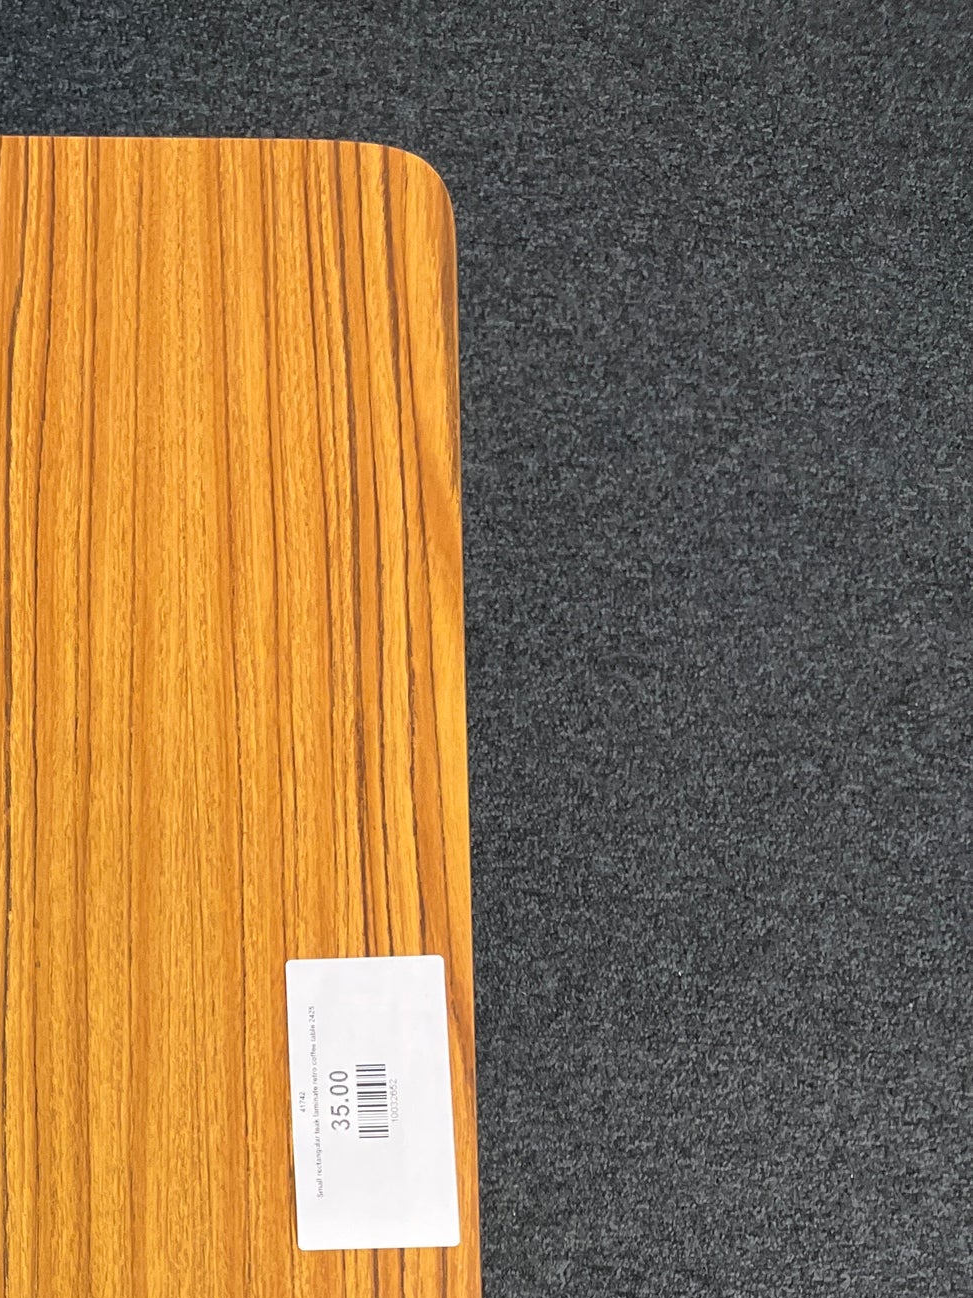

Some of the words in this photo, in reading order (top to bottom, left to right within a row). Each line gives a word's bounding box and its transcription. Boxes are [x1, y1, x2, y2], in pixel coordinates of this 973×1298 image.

[312, 1087, 320, 1117] laminate
[329, 1070, 350, 1131] 35.00
[314, 1136, 323, 1176] rectangular
[316, 1179, 324, 1198] Small
